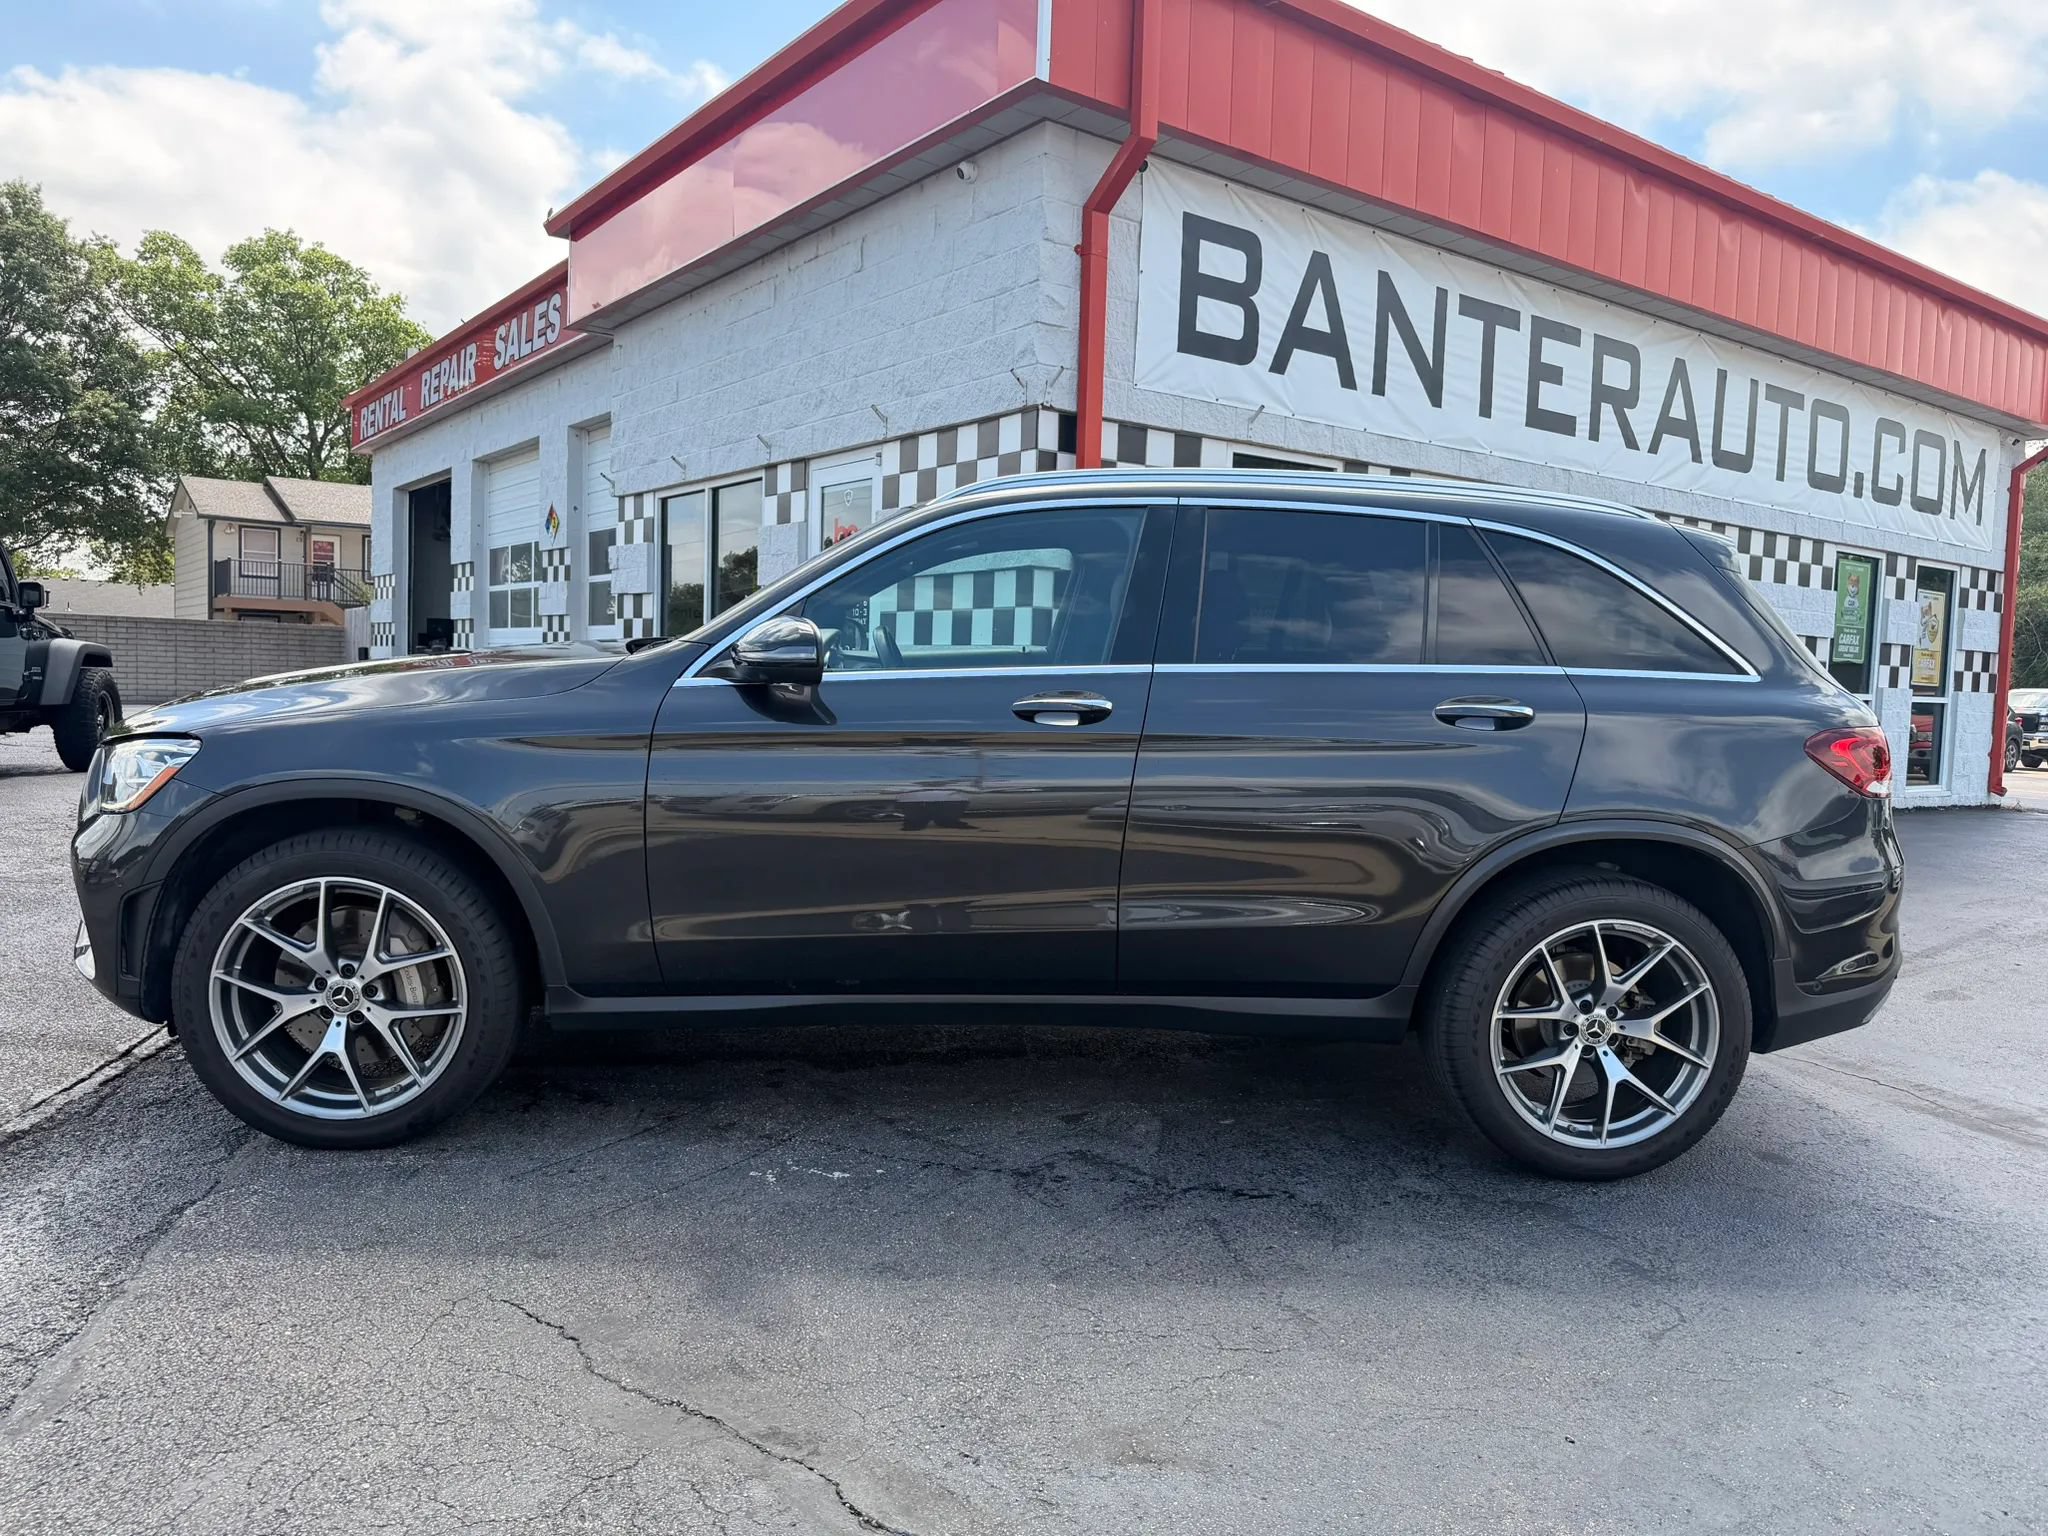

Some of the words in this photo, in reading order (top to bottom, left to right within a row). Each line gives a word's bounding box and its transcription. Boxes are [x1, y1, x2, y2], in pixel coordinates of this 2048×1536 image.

[360, 386, 407, 442] RENTAL
[420, 342, 478, 411] REPAIR
[492, 292, 562, 371] SALES
[1177, 211, 1987, 526] BANTERAUTO.COM
